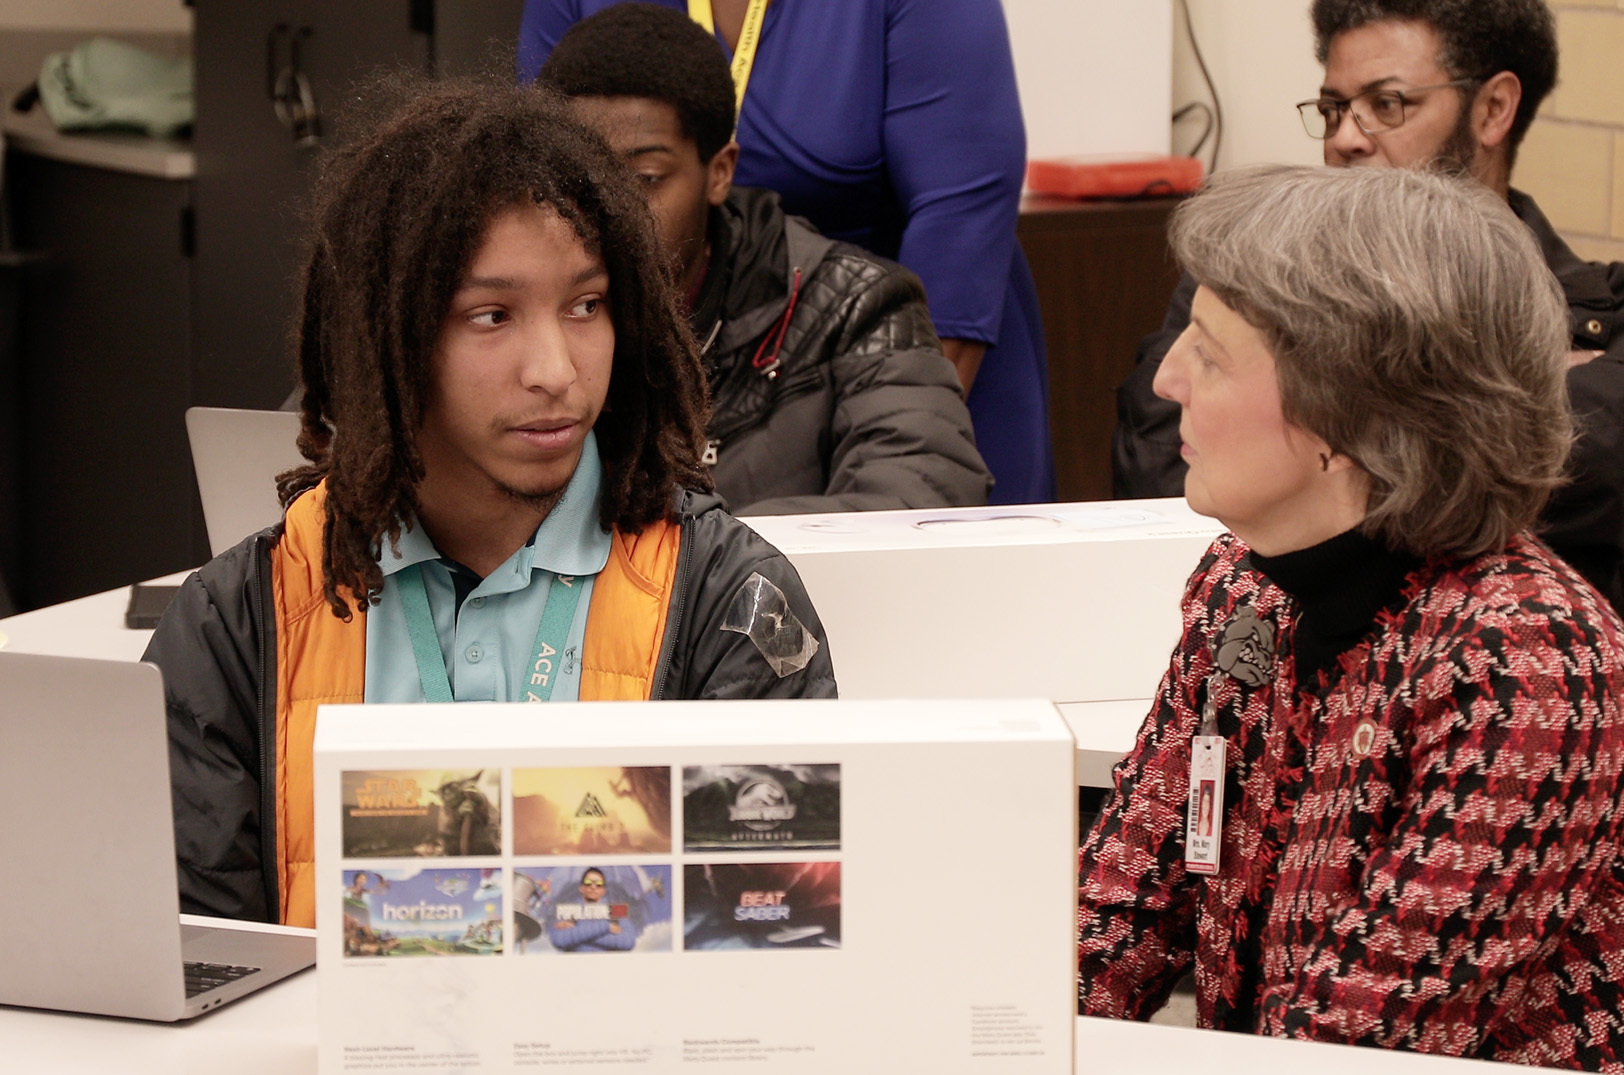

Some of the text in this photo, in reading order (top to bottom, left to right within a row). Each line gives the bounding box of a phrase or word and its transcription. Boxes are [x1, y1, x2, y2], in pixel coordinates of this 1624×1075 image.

[531, 642, 557, 687] ACE
[355, 778, 422, 794] STAR
[356, 792, 419, 809] WARS
[740, 891, 786, 907] BEAT
[383, 900, 463, 921] horizon
[734, 905, 791, 921] SABER
